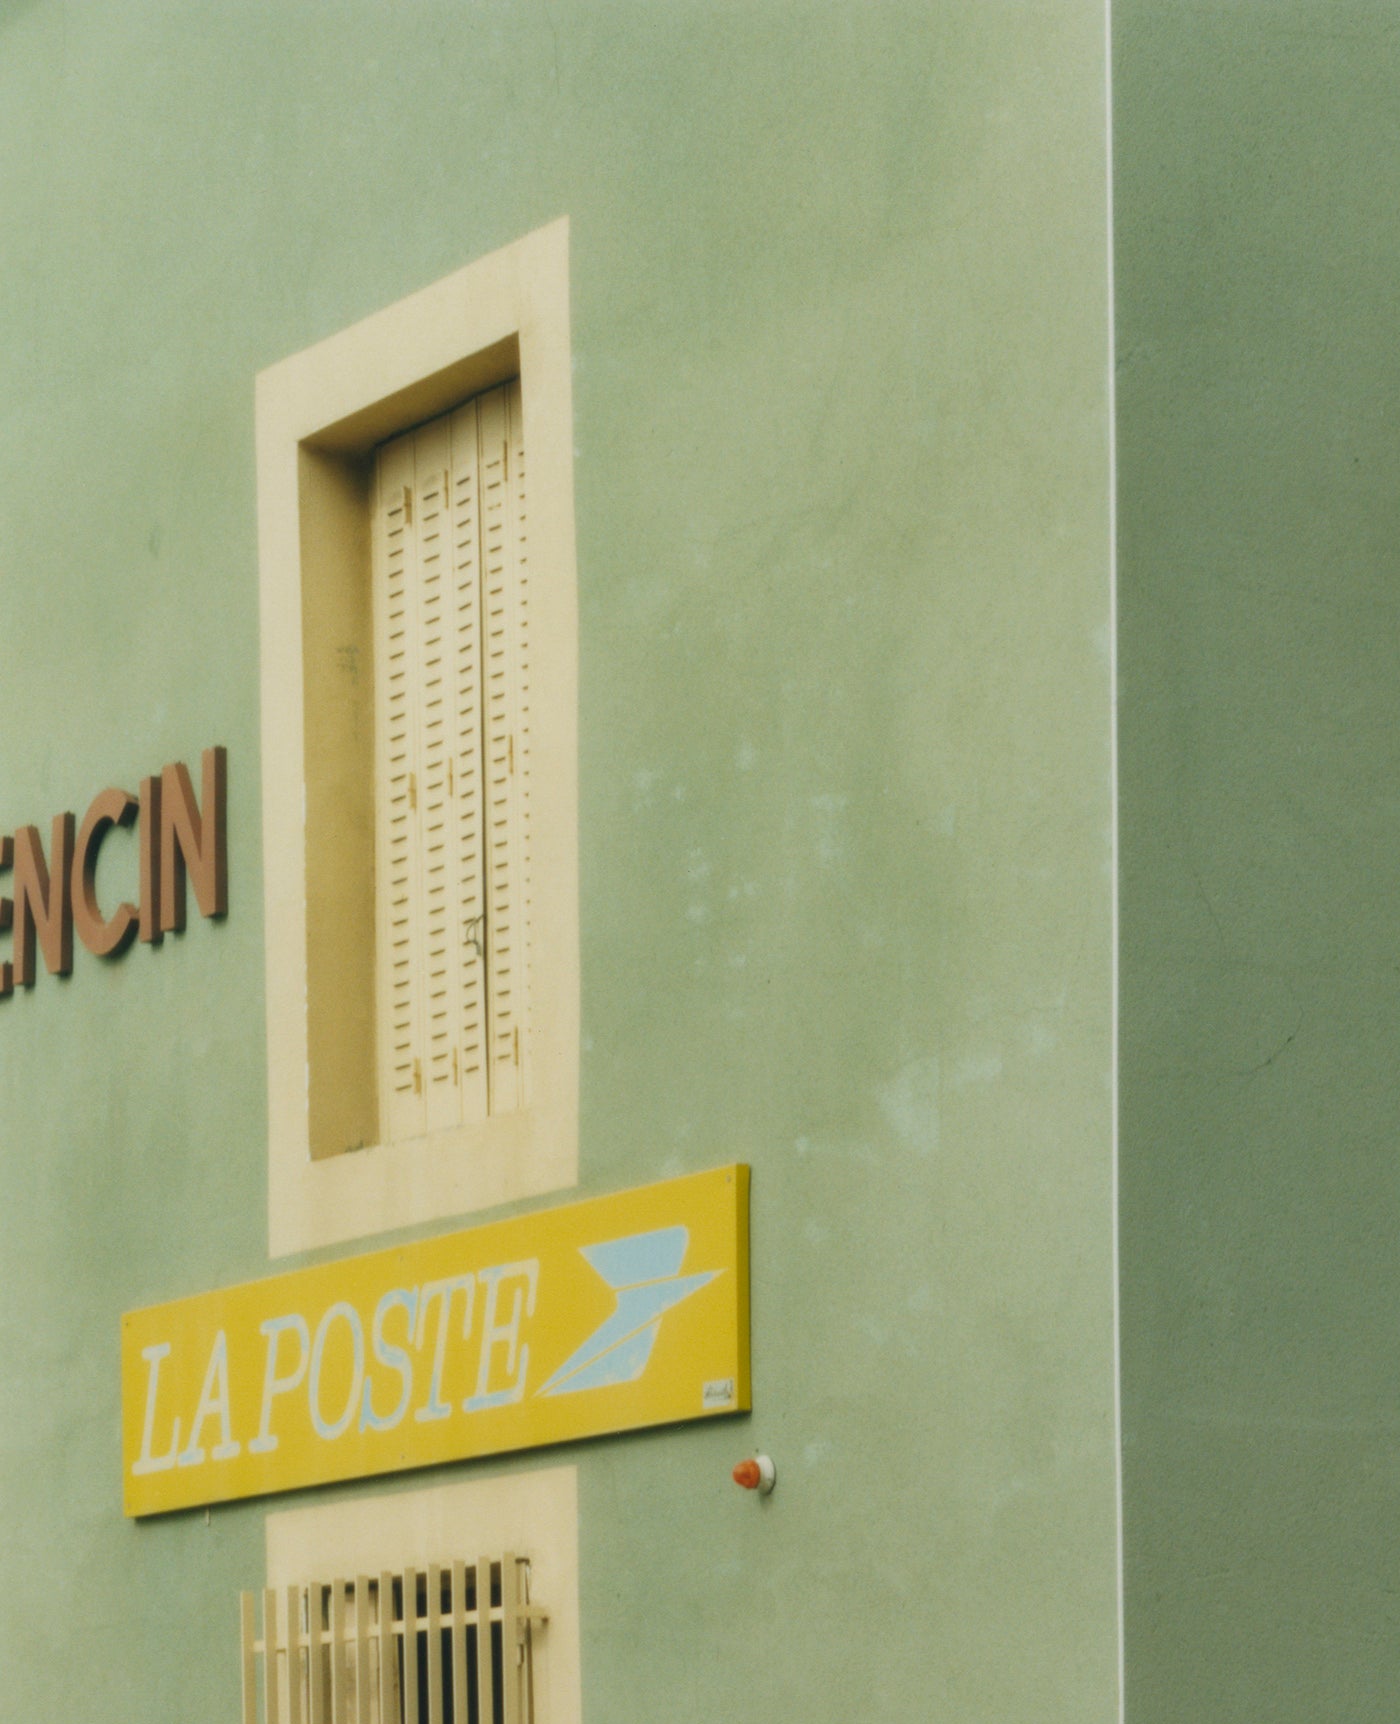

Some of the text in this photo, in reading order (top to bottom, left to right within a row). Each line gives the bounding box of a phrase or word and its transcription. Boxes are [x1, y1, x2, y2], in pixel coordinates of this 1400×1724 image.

[0, 745, 228, 997] NCIN
[133, 1258, 540, 1476] LA POSTE
